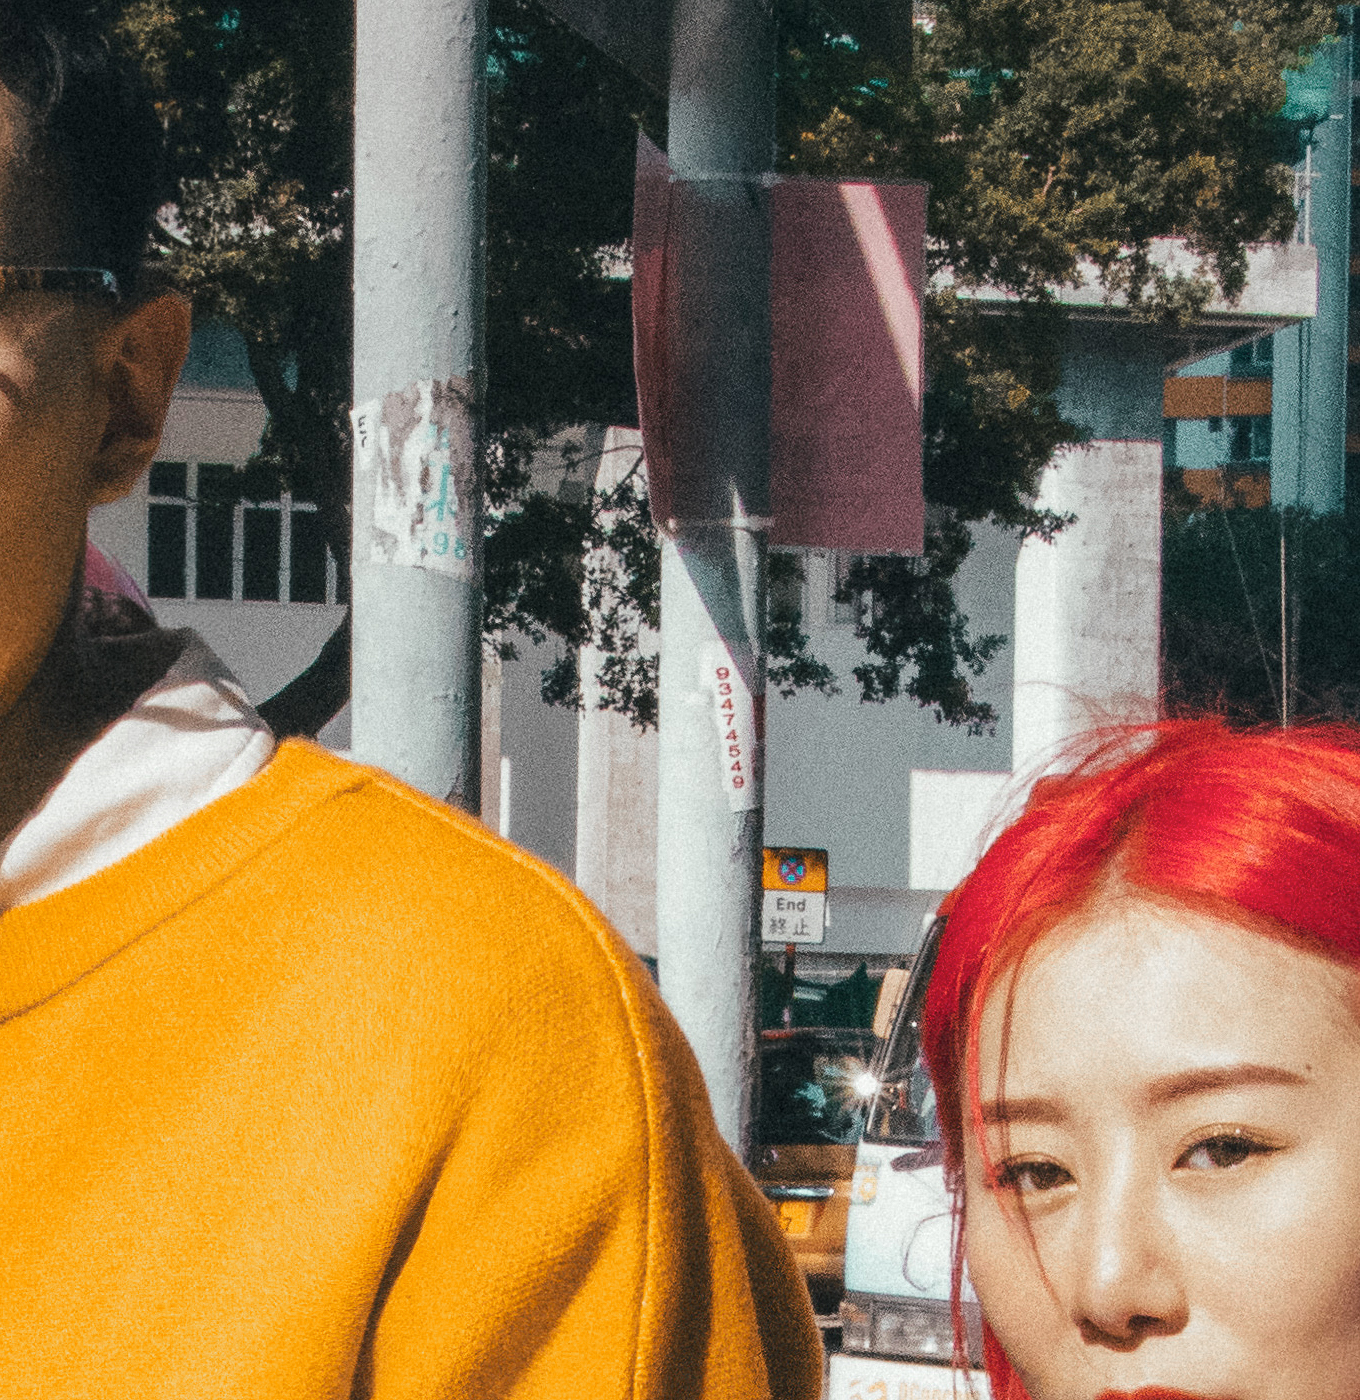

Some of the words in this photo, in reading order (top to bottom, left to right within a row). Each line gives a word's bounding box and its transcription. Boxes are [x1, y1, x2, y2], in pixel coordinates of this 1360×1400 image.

[715, 667, 745, 789] 93474549
[776, 897, 807, 912] End
[768, 916, 811, 936] 終止
